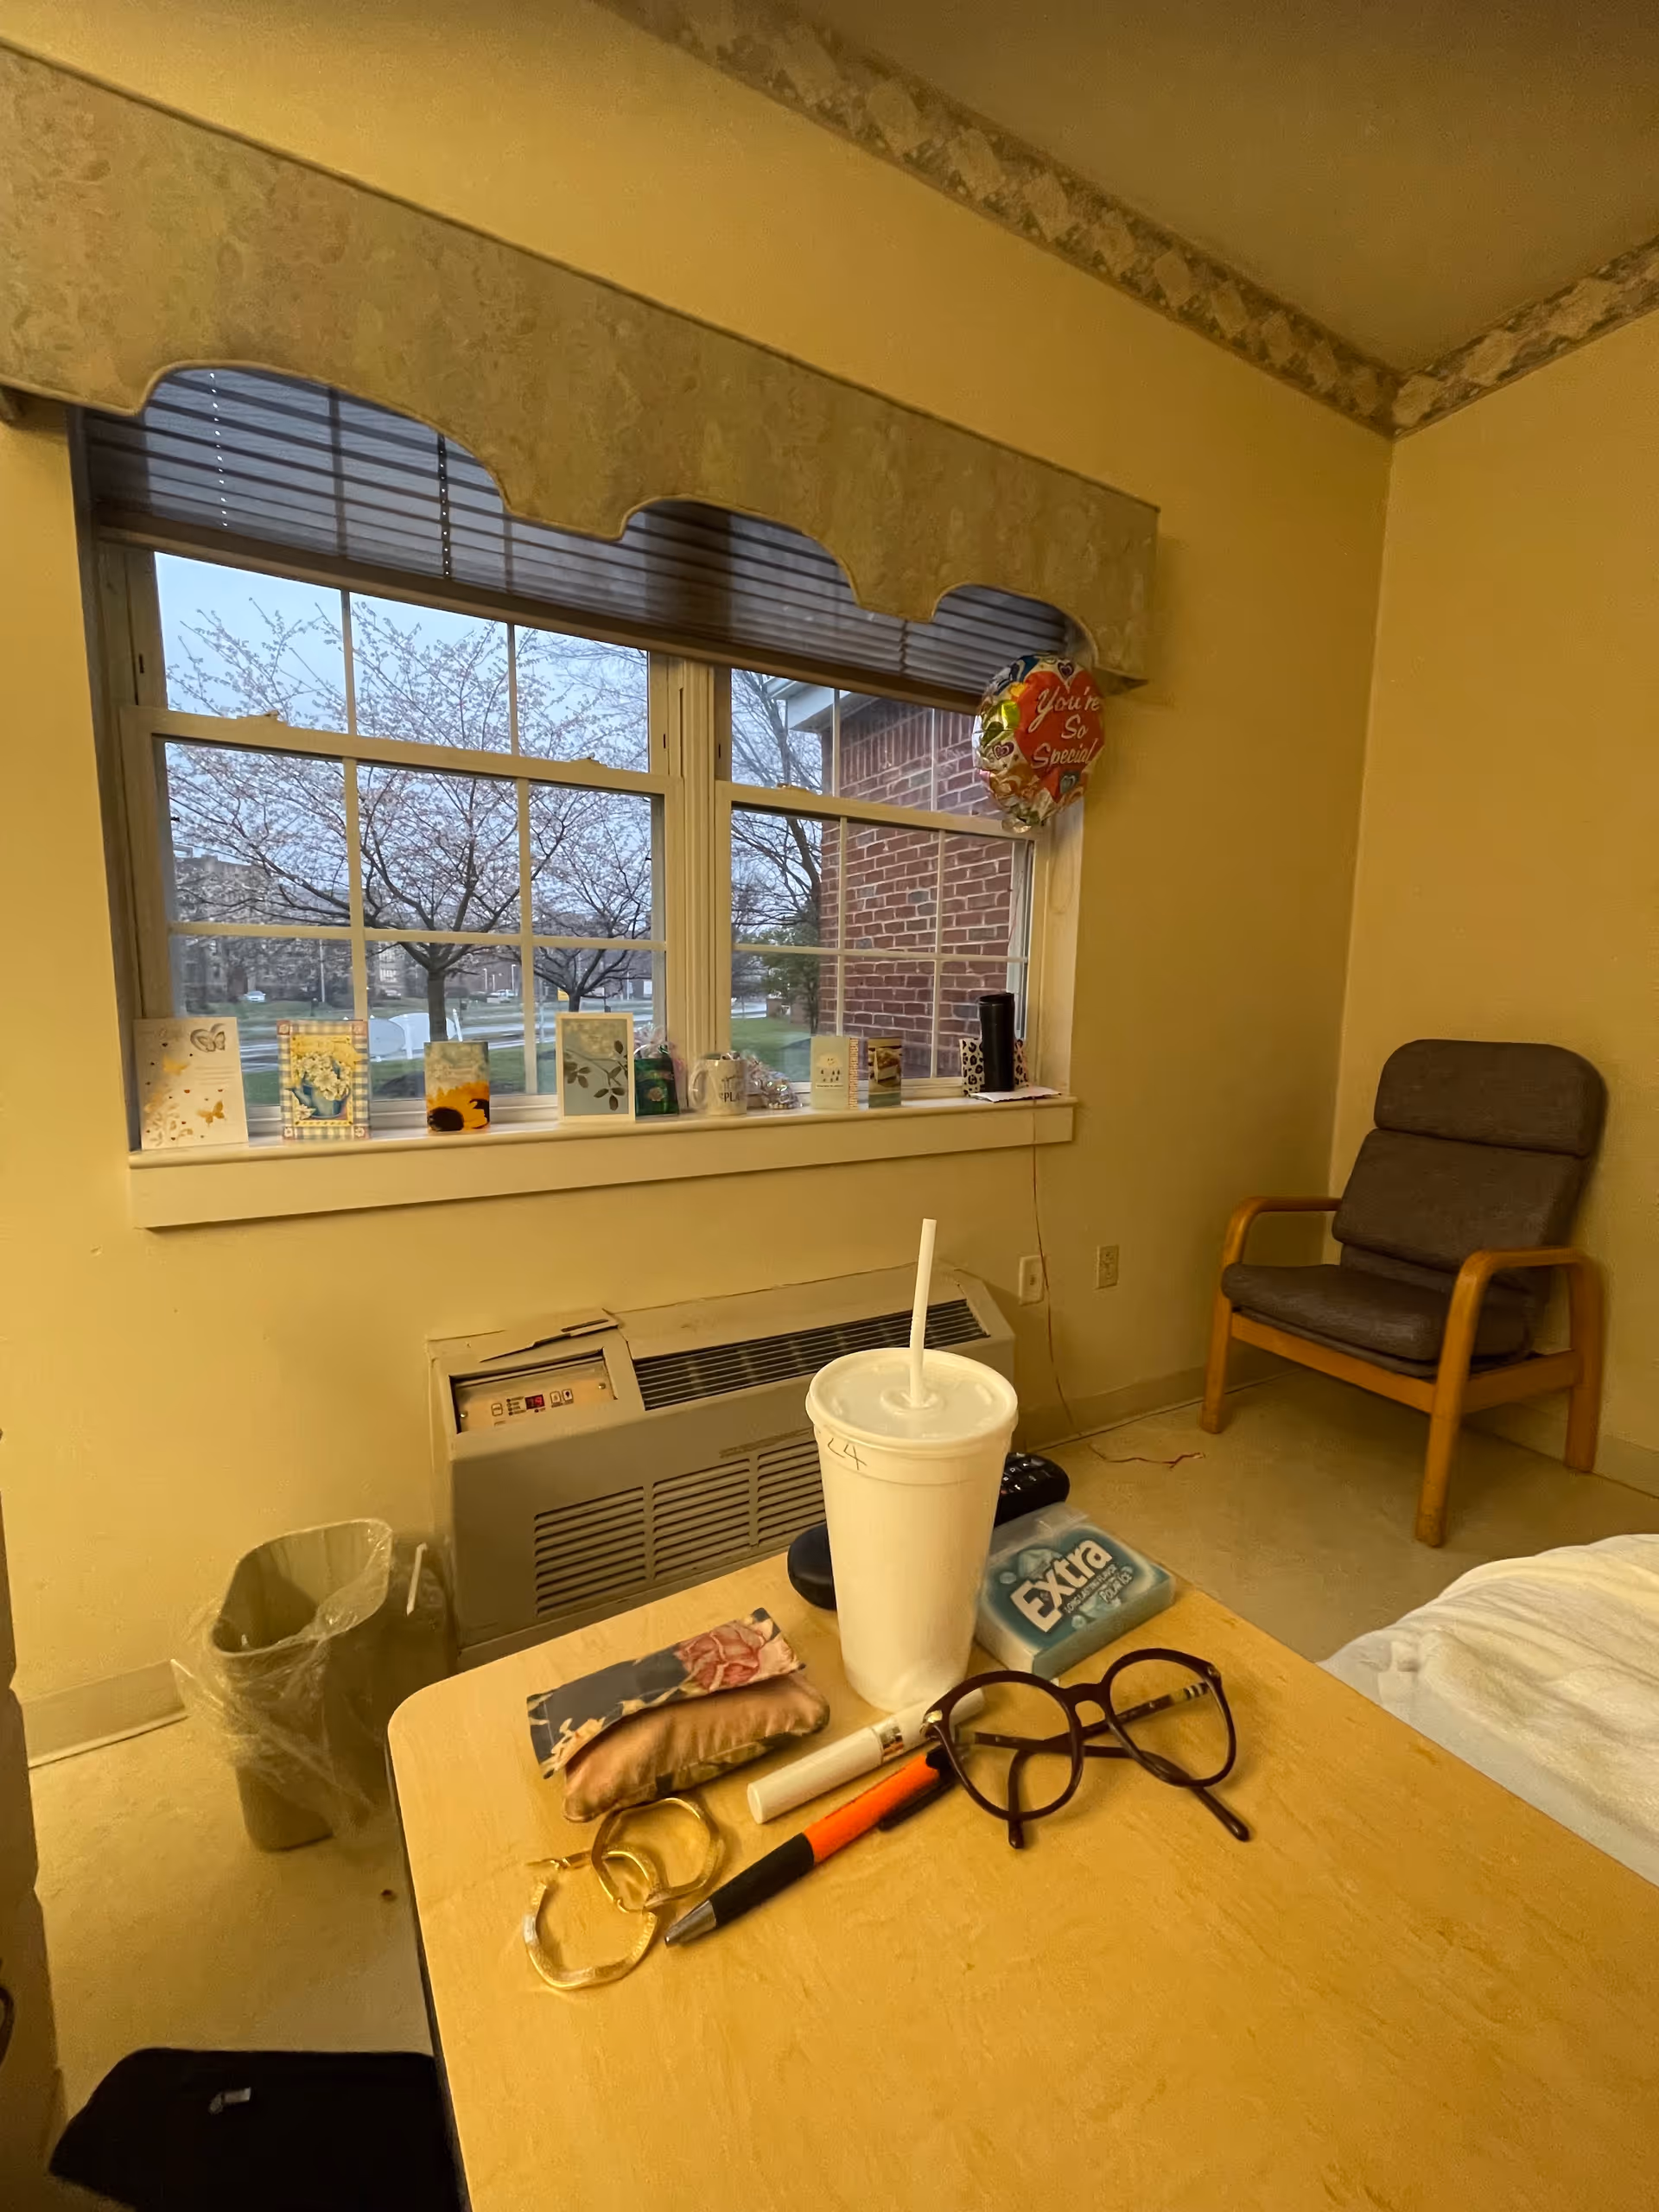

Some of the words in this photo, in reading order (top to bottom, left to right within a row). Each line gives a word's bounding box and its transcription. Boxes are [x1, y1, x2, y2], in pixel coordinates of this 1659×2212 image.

[1028, 687, 1100, 733] You're
[1061, 714, 1089, 740] So
[1031, 738, 1098, 769] Special
[1010, 1540, 1113, 1633] Extra
